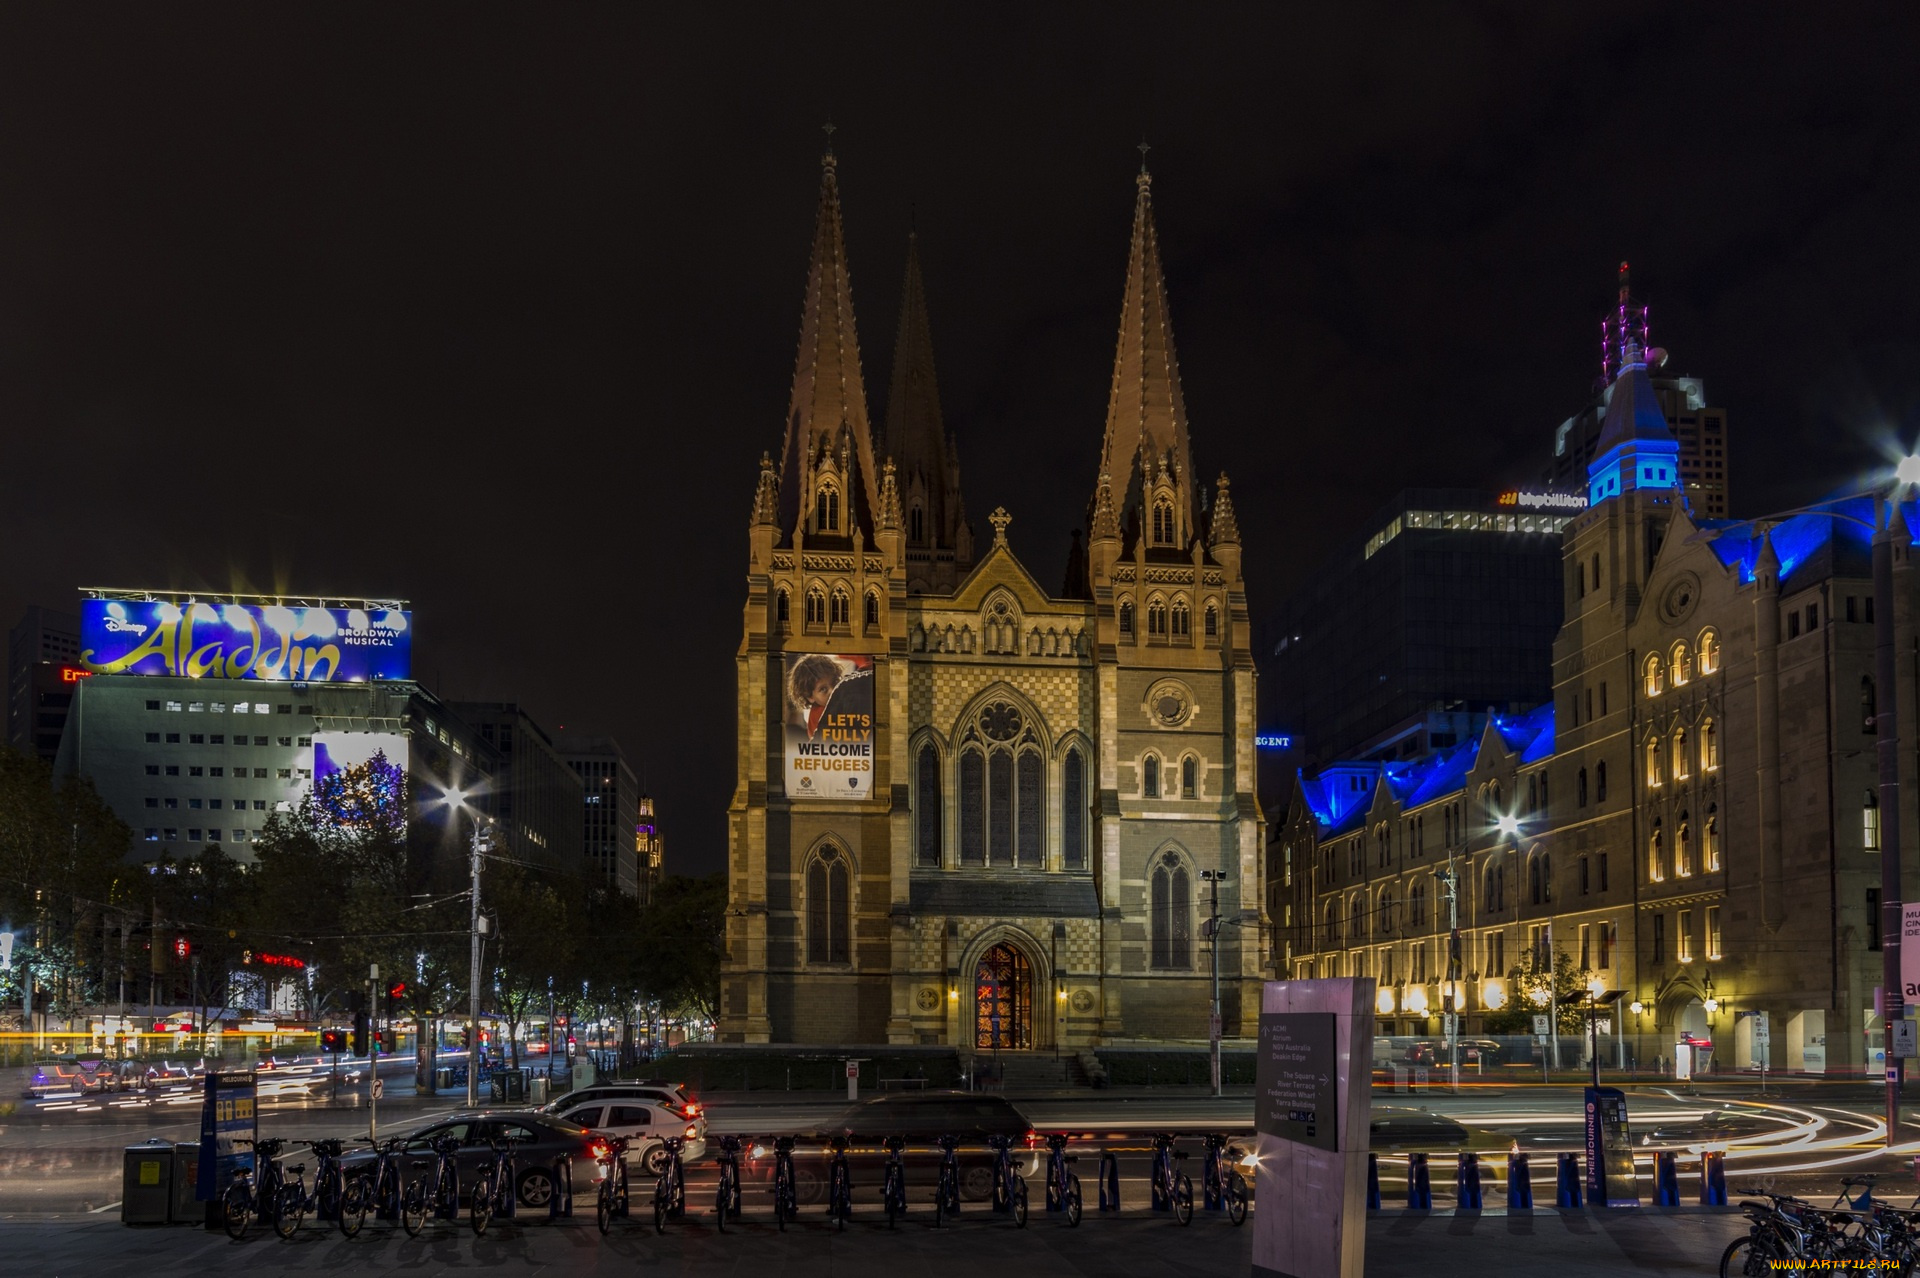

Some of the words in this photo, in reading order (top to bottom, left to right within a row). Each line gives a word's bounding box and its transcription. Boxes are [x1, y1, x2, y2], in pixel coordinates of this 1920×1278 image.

[103, 617, 147, 637] Disney
[338, 628, 400, 637] BROADWAY
[81, 602, 341, 682] Aladdin
[345, 638, 393, 646] MUSICAL
[828, 714, 870, 727] LET'S
[822, 729, 870, 741] FULLY
[798, 744, 870, 756] WELCOME
[794, 758, 870, 771] REFUGEES
[1292, 1054, 1306, 1062] Edge
[221, 1075, 248, 1083] MELBOURNE
[1294, 1072, 1315, 1080] Square
[1268, 1089, 1297, 1097] Federation
[1292, 1100, 1315, 1110] Building
[1271, 1112, 1288, 1120] Toilets
